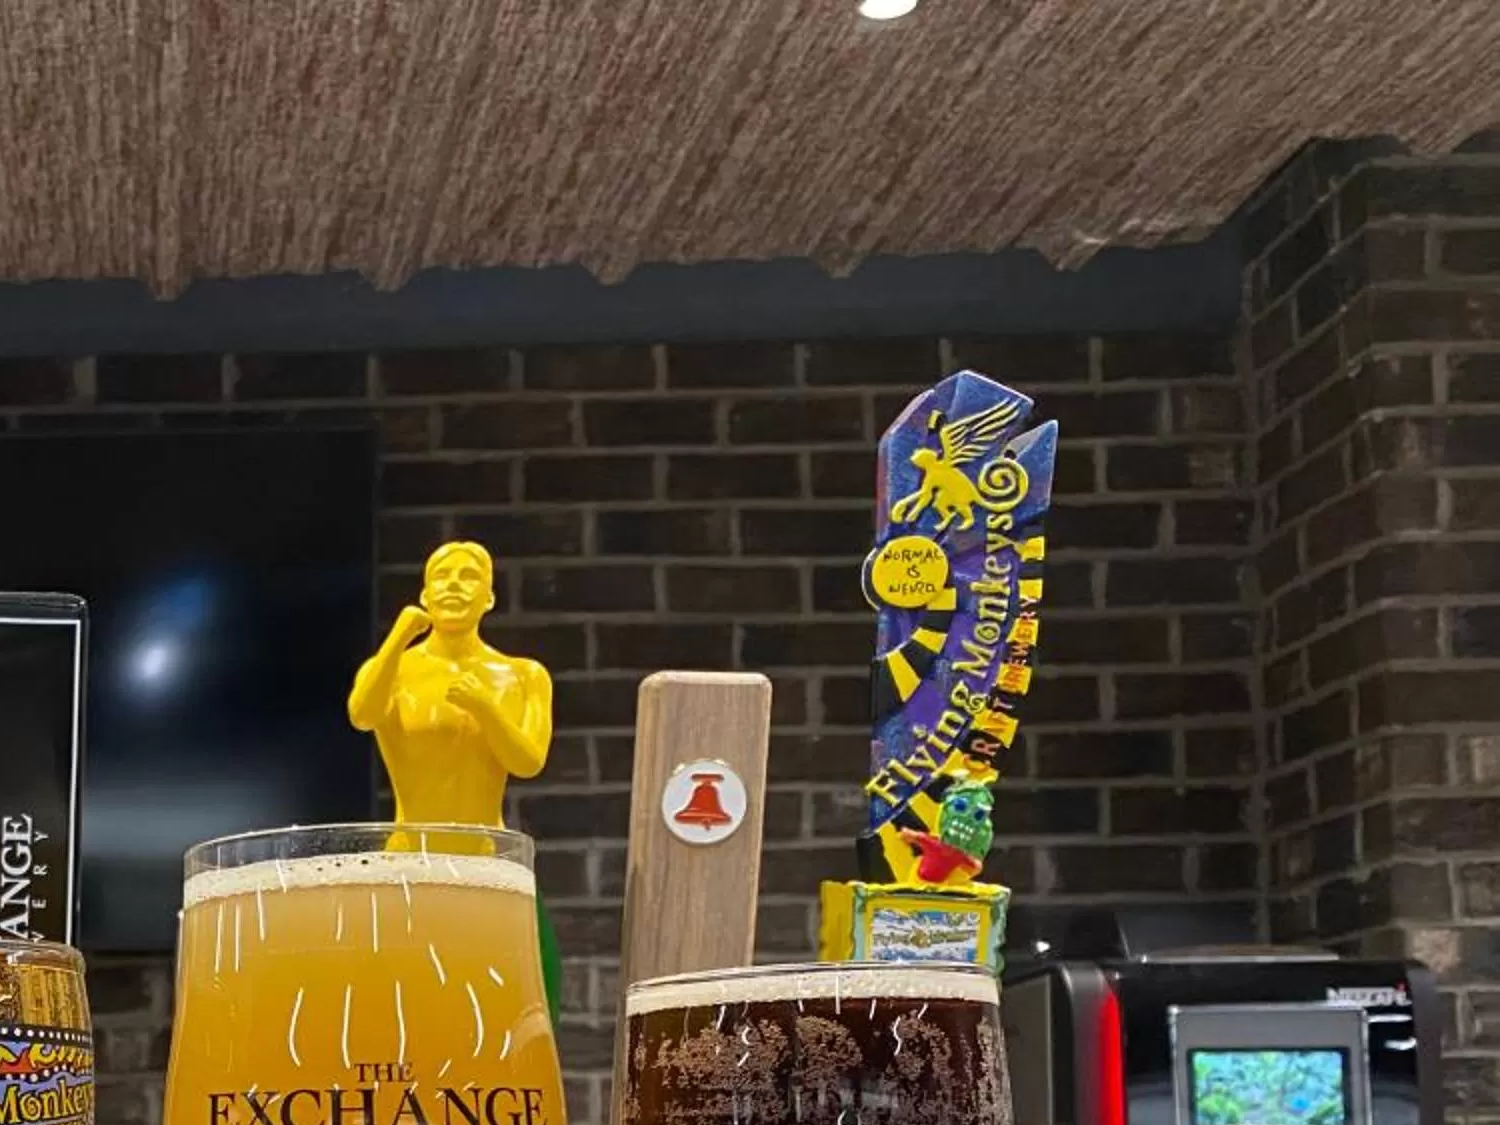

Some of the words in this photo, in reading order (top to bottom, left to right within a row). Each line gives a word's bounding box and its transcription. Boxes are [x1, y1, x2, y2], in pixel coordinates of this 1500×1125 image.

[864, 680, 988, 808] Flying
[951, 513, 1015, 679] Monkeys
[0, 812, 32, 940] ANGE
[354, 1062, 414, 1084] THE
